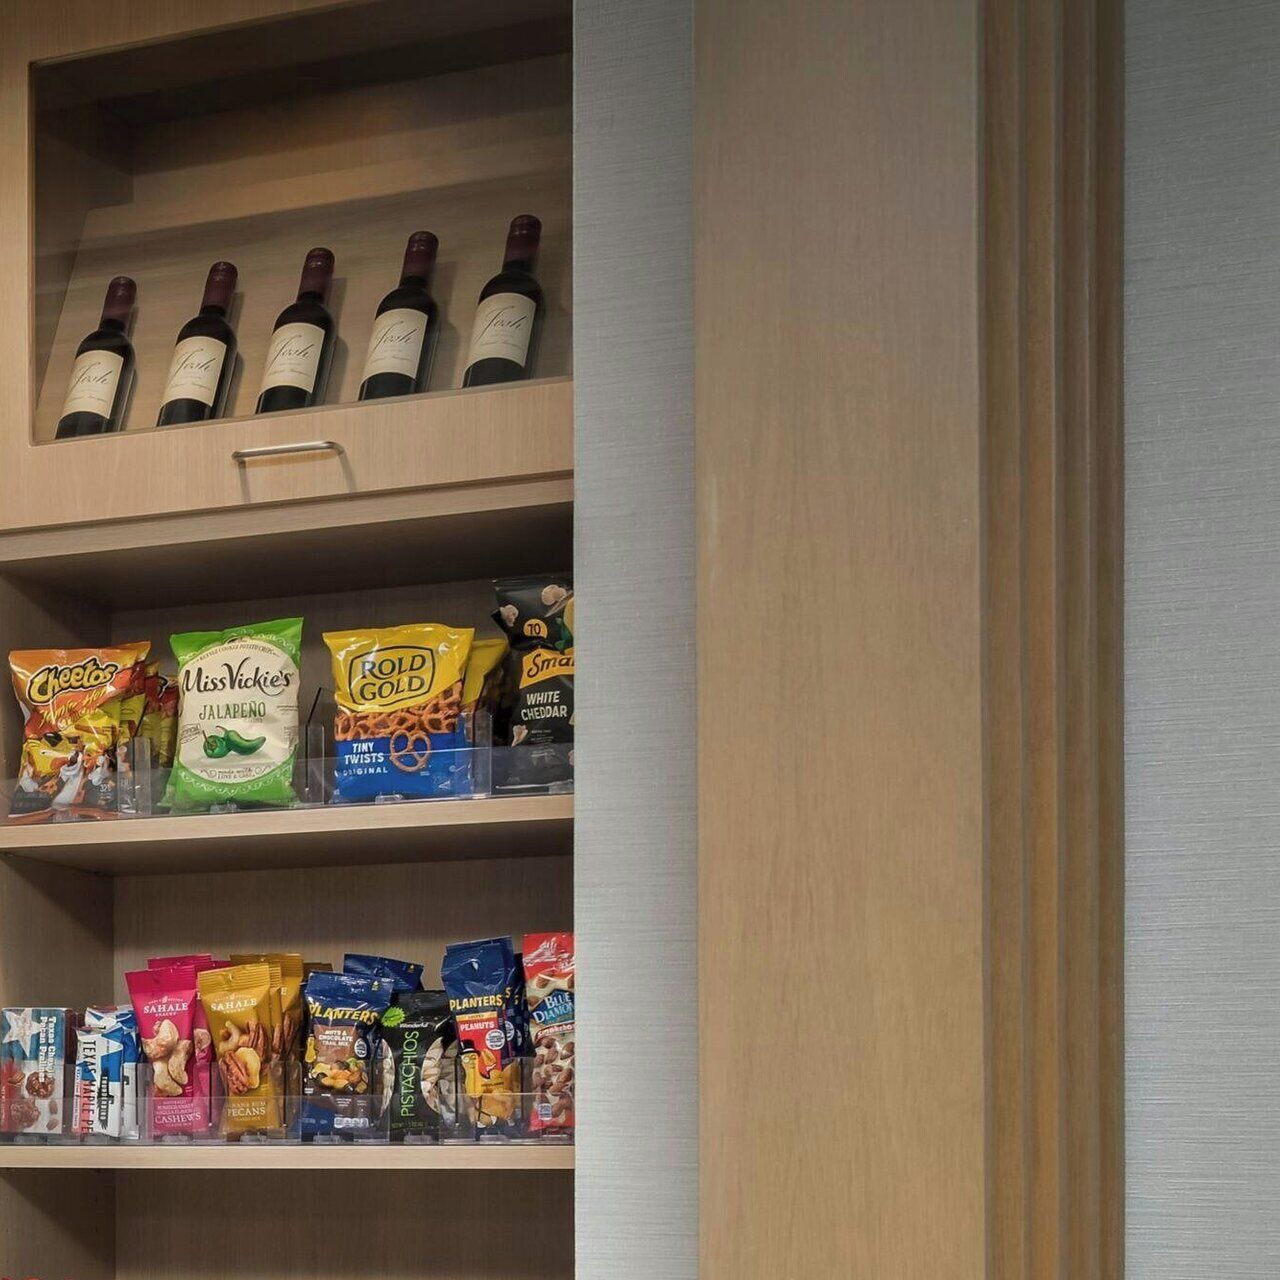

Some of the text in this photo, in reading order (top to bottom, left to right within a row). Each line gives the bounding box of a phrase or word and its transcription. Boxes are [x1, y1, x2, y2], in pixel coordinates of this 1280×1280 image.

[362, 654, 427, 681] ROLD
[29, 657, 119, 704] Cheetos
[183, 657, 292, 697] Miss Vickie's
[359, 676, 426, 702] GOLD
[526, 690, 560, 705] WHITE
[198, 700, 267, 721] JALAPEÑO
[521, 705, 568, 721] CHEDDAR
[352, 742, 374, 753] TINY
[344, 752, 385, 765] TWISTS
[143, 1002, 189, 1015] SAHALE
[210, 997, 258, 1012] SAHALE
[449, 994, 503, 1011] PLANTERS
[544, 992, 573, 1010] BLUE
[308, 1002, 379, 1027] PLANTERS
[47, 1016, 57, 1044] Texas
[459, 1021, 496, 1032] PEANUTS
[318, 1034, 354, 1042] CHOCOLATE
[82, 1040, 96, 1117] TEXAS MAPLE
[400, 1031, 420, 1118] PISTACHIOS
[154, 1111, 202, 1125] CASHEWS
[227, 1107, 267, 1118] PECANS
